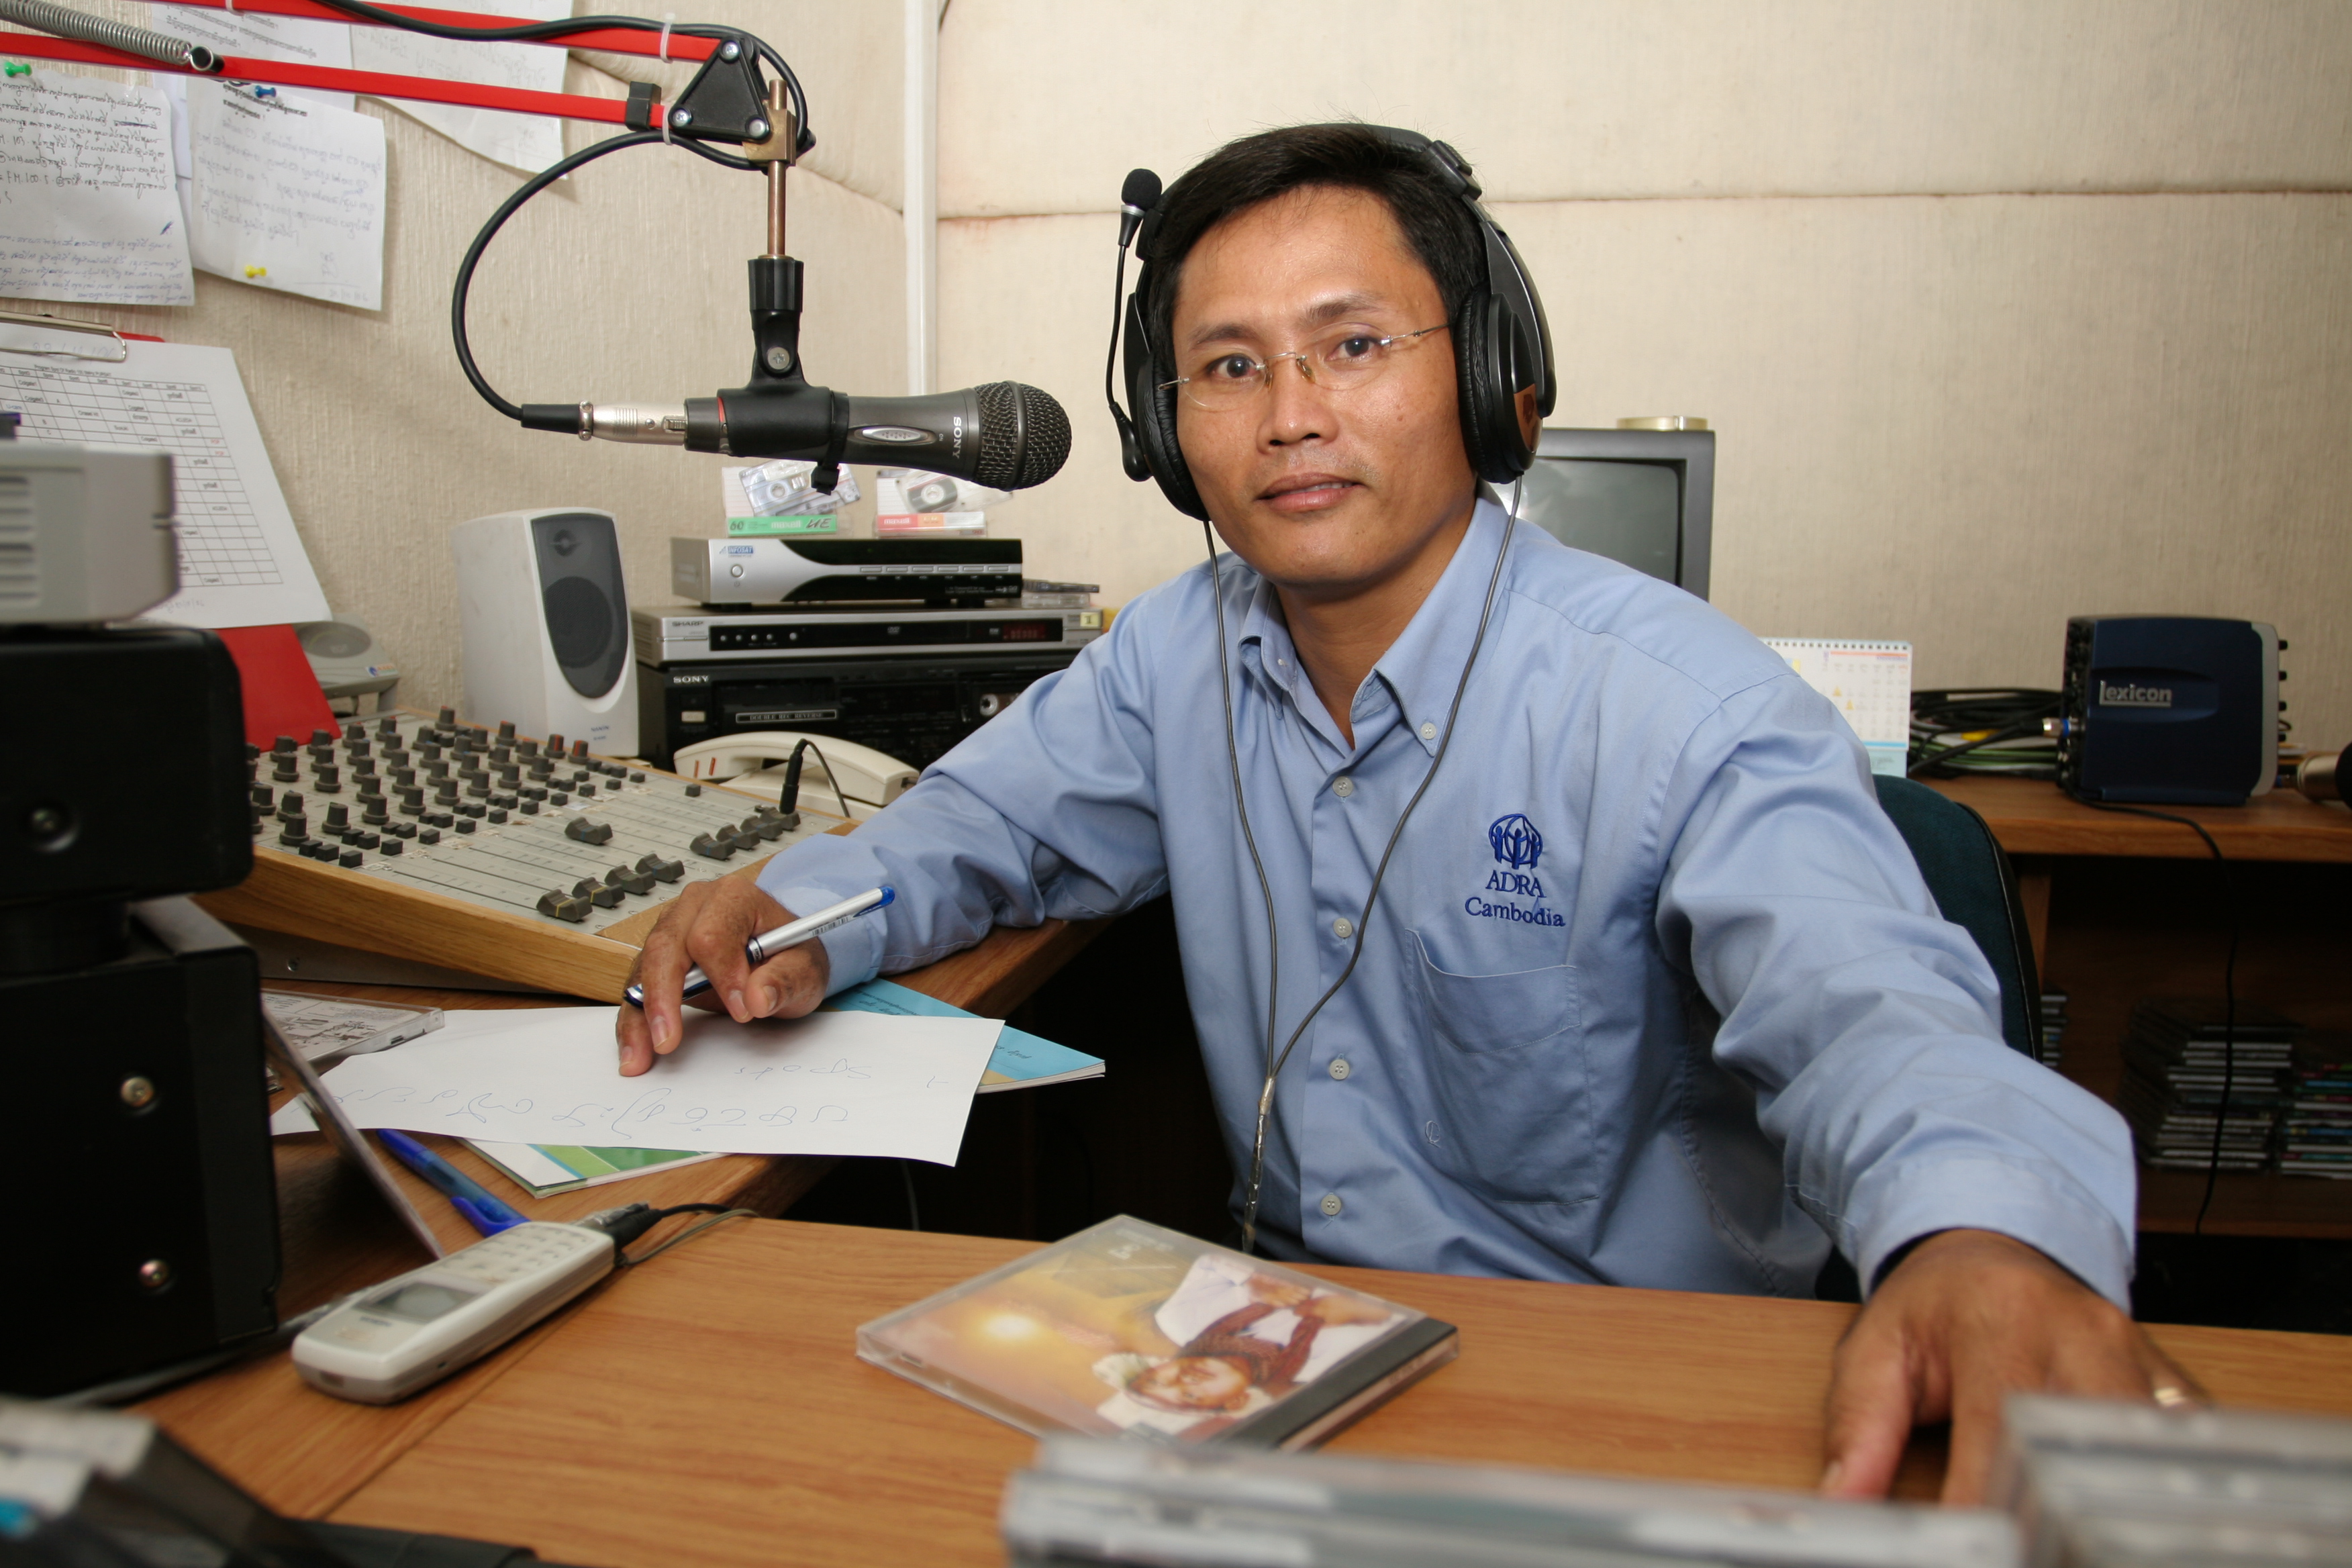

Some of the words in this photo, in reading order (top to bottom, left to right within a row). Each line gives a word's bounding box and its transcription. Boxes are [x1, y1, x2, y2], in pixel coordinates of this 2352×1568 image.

[952, 416, 962, 459] SONY
[730, 521, 744, 530] 60
[771, 520, 802, 529] maxell
[728, 546, 753, 554] INFOSAT
[1084, 615, 1092, 624] 1
[673, 675, 709, 683] SONY
[1485, 869, 1547, 898] ADRA
[1465, 896, 1566, 927] Cambodia
